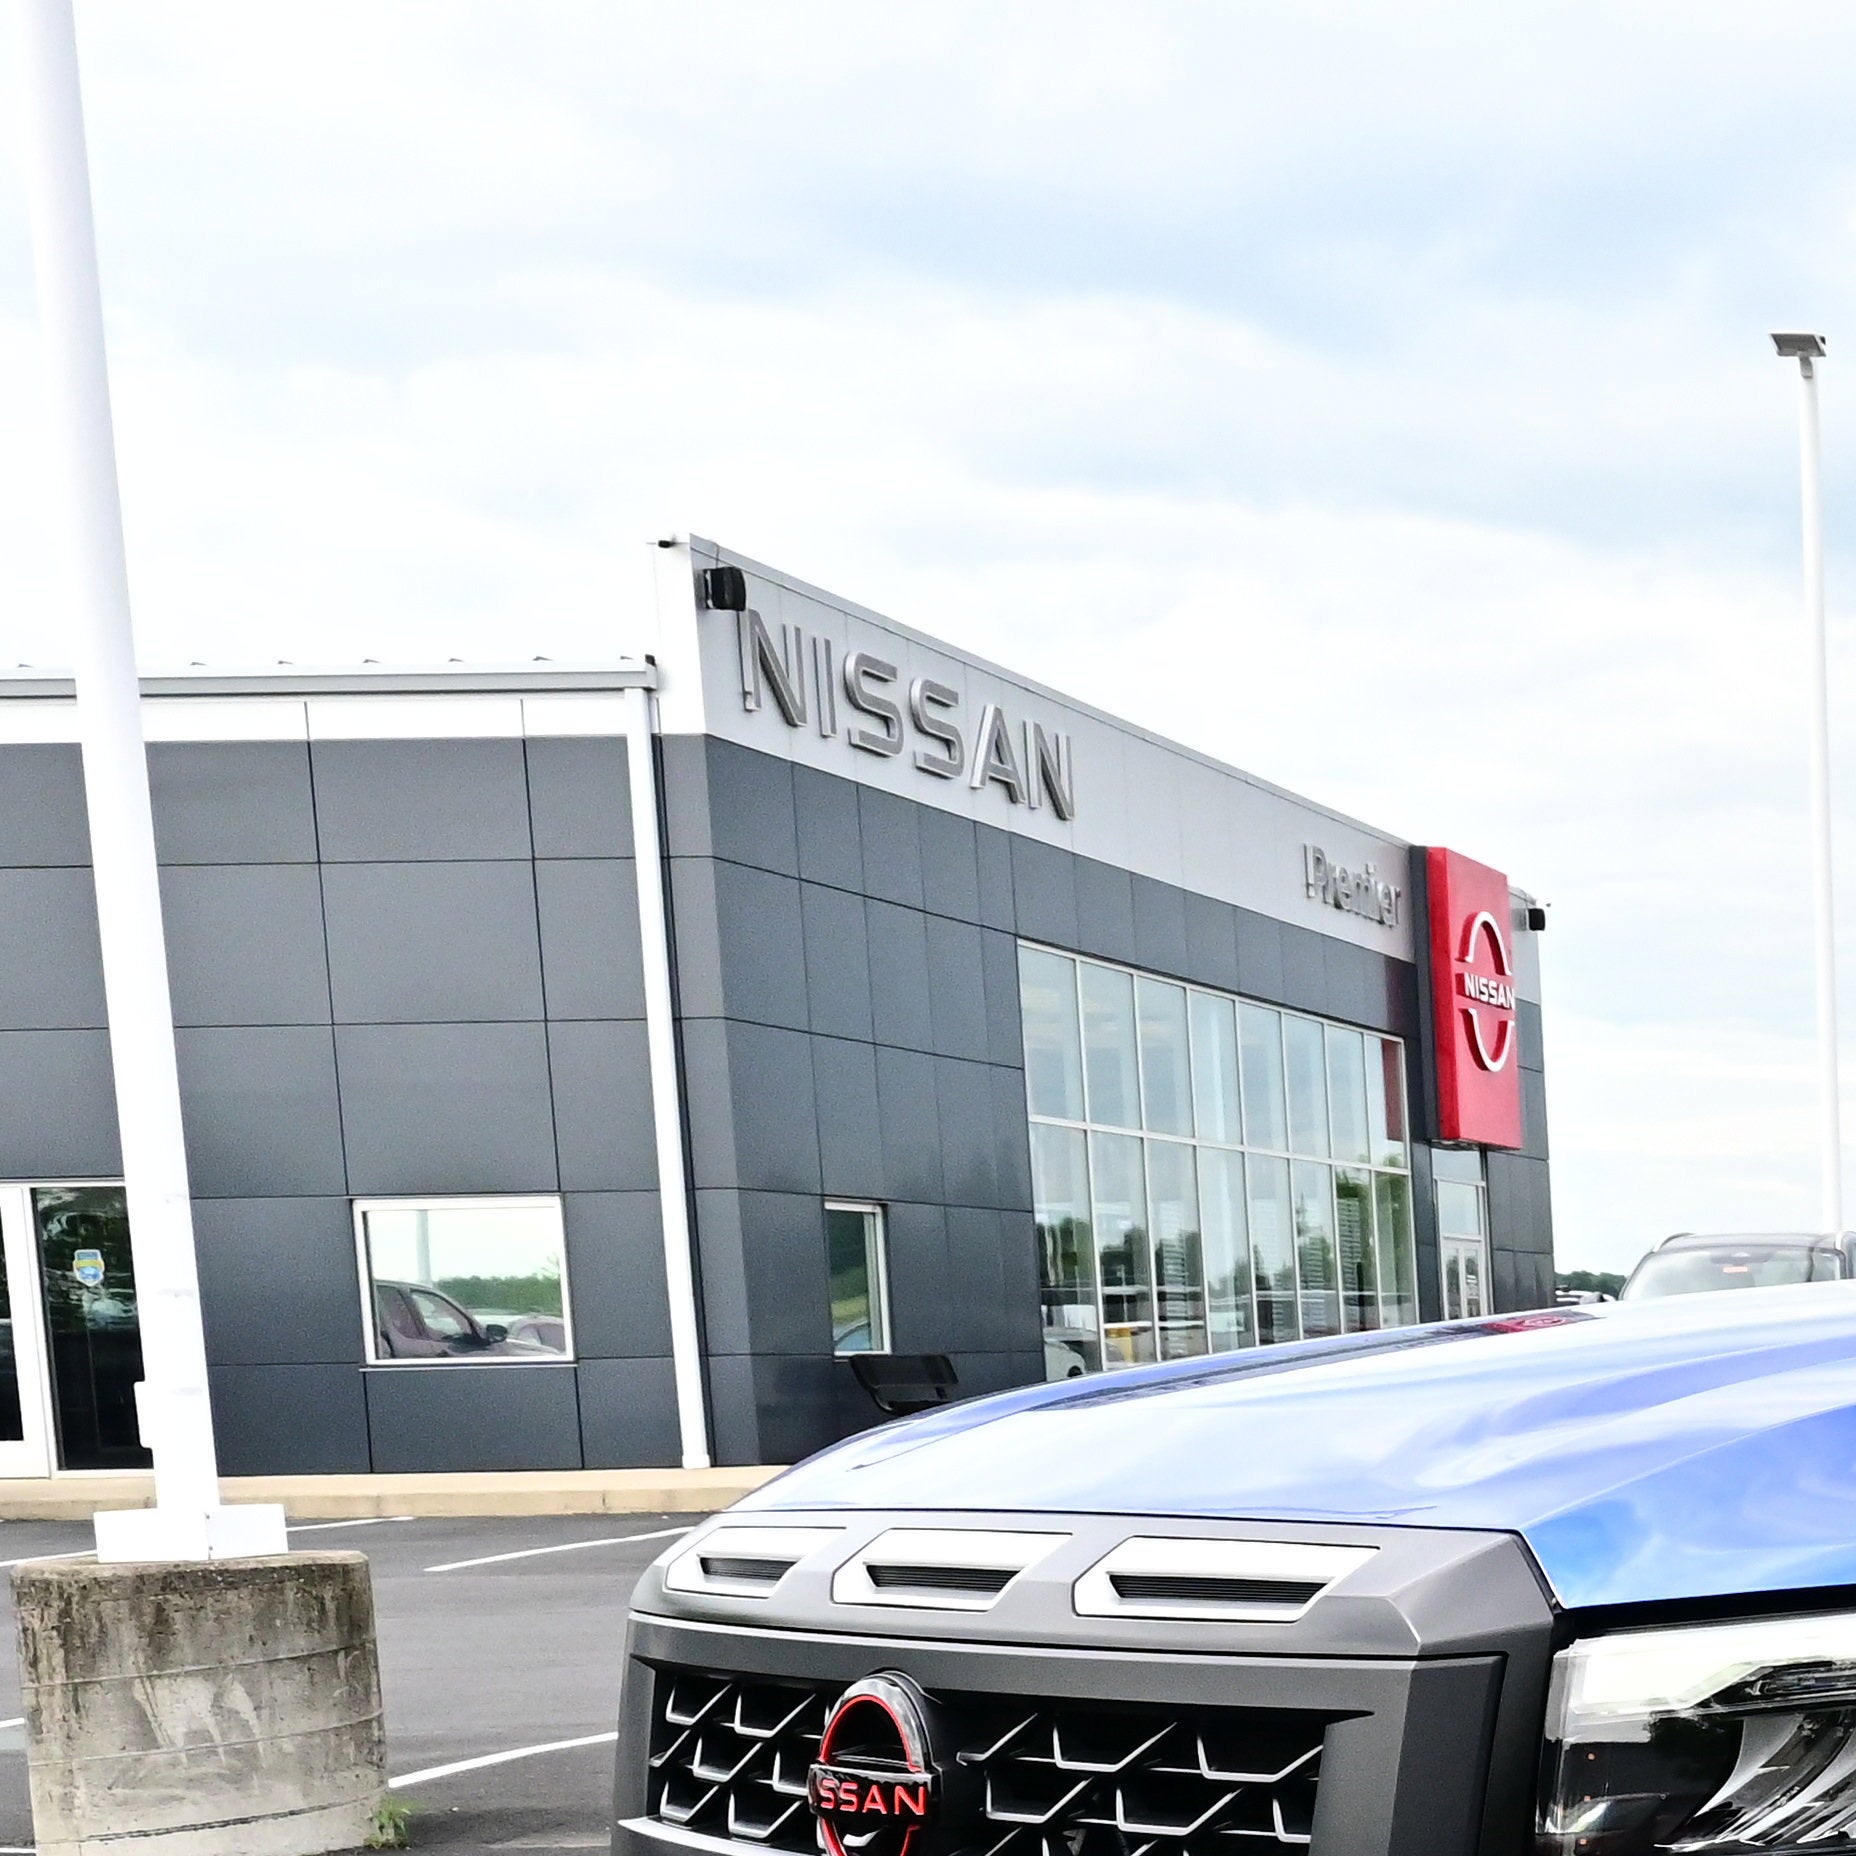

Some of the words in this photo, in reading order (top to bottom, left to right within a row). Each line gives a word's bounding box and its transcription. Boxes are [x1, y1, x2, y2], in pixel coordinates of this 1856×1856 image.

[737, 607, 1075, 822] NISSAN
[1303, 843, 1401, 929] Premier
[1462, 971, 1516, 1011] NISSAN
[818, 1777, 926, 1816] SSAN
